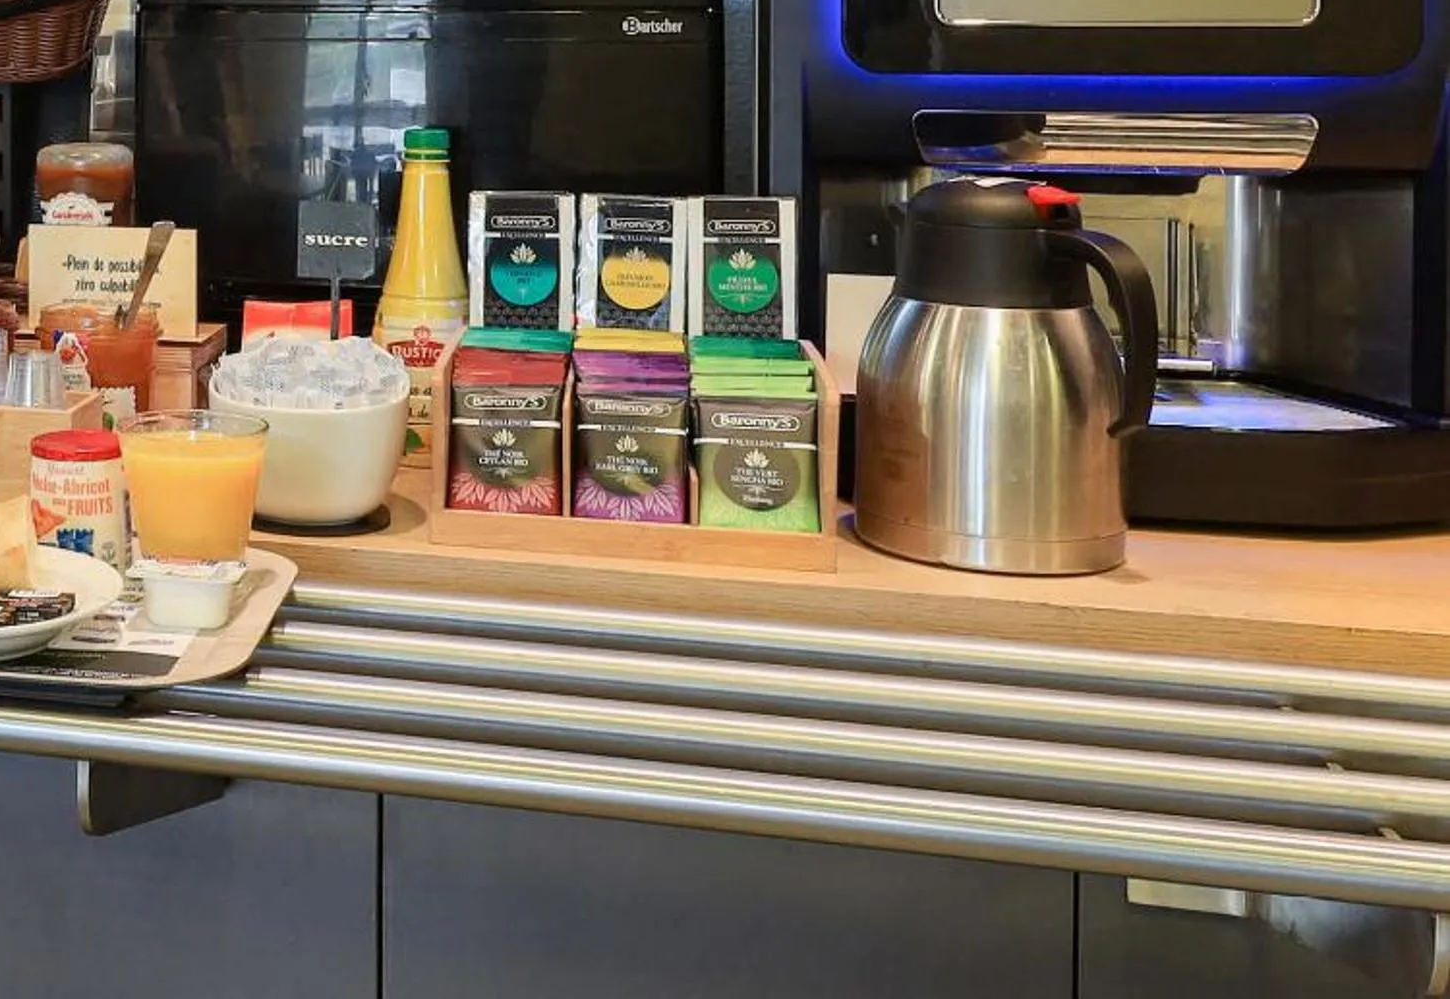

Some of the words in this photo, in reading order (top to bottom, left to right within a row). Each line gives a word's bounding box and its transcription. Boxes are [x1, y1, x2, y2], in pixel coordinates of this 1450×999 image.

[622, 16, 683, 35] Bartscher
[304, 233, 368, 247] sucre
[68, 496, 113, 517] FRUITS
